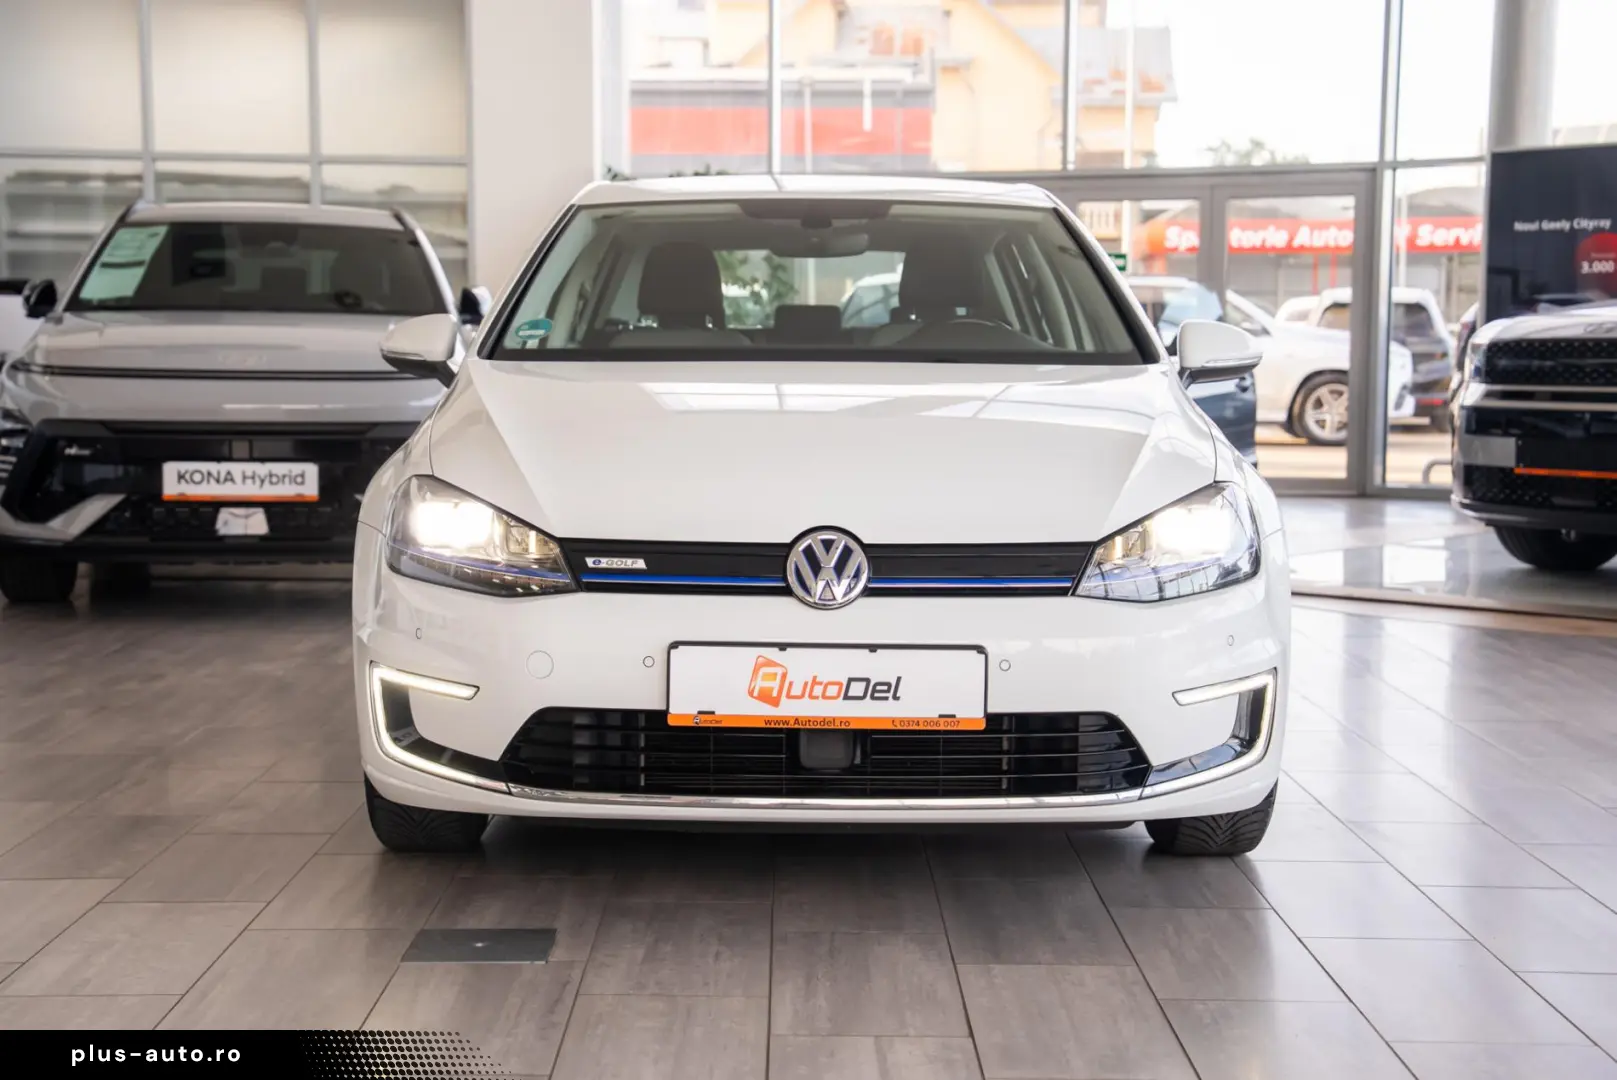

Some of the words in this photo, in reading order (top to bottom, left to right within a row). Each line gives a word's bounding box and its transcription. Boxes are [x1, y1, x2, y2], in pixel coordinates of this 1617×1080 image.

[1293, 224, 1353, 248] Auto
[1415, 223, 1483, 247] Servi
[1581, 260, 1615, 274] 3.000
[177, 469, 236, 486] KONA
[242, 469, 306, 489] Hybrid
[592, 558, 638, 567] e-GOLF
[749, 658, 902, 705] AutoDel
[764, 717, 851, 728] www.Autodel.ro
[900, 720, 920, 728] 0374
[923, 720, 941, 728] 006
[943, 720, 960, 728] 007
